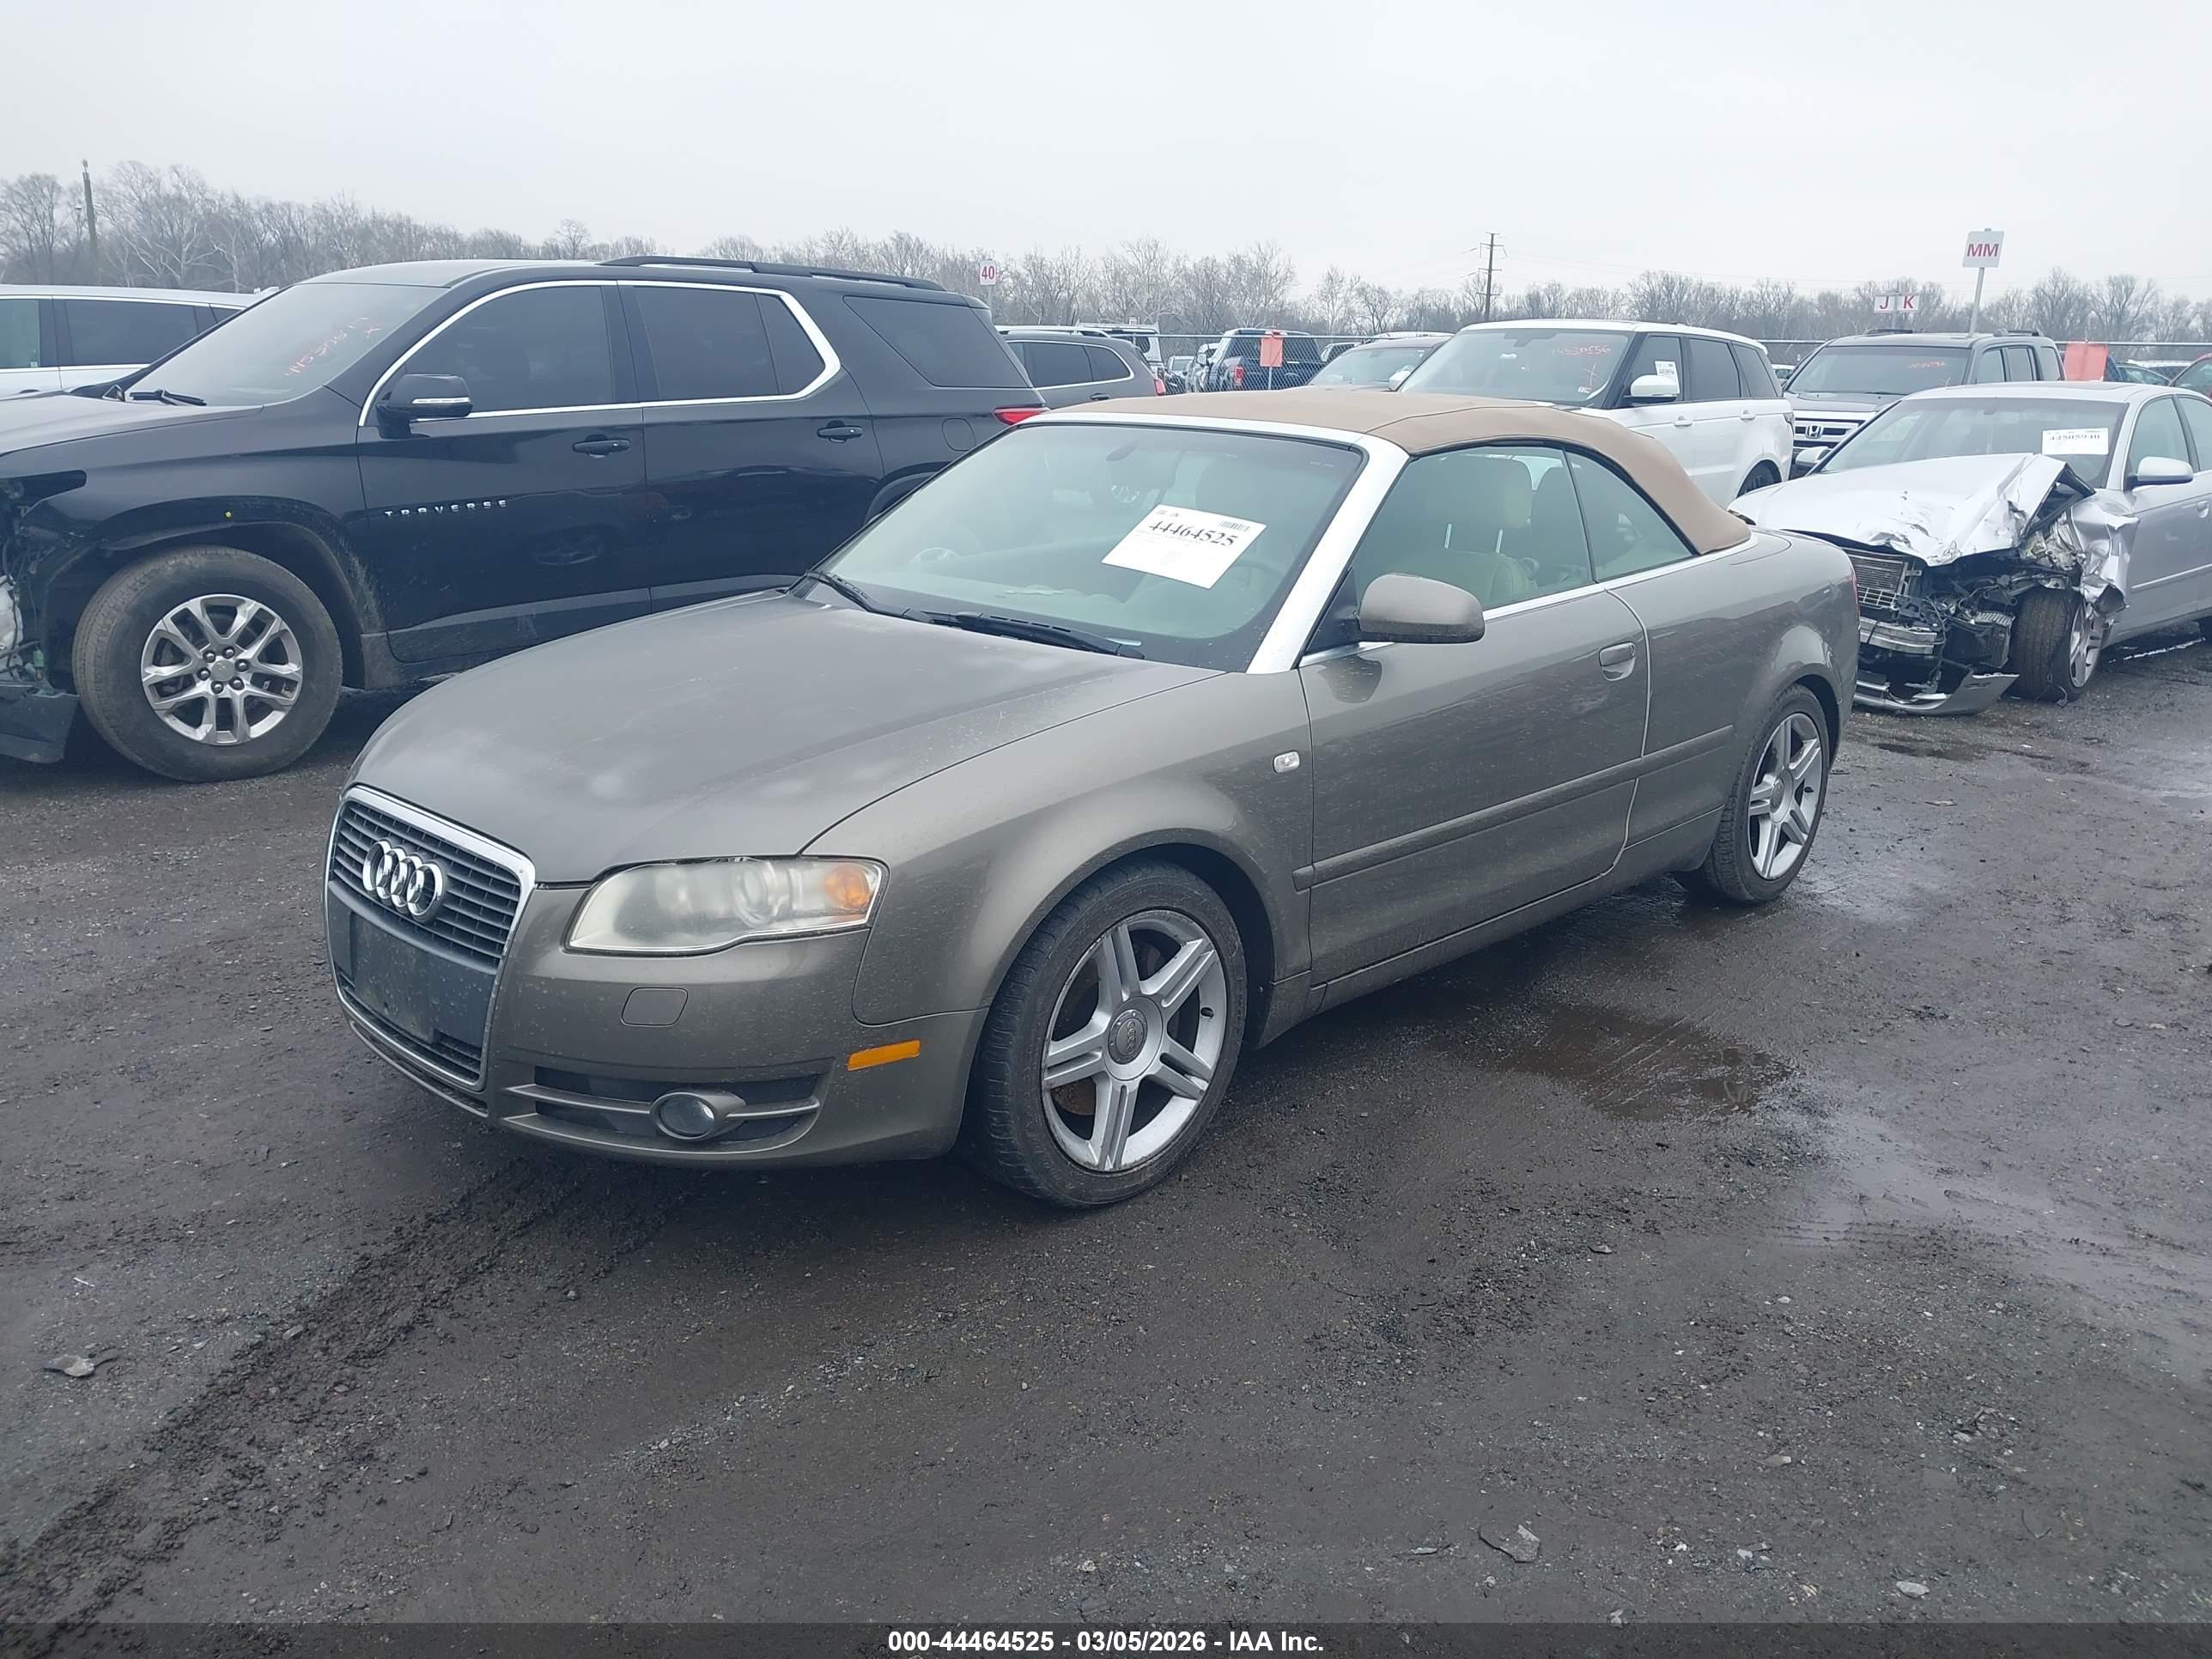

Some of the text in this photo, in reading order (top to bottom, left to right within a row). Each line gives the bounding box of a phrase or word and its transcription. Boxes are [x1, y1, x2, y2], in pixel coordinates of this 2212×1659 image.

[1966, 243, 1999, 258] MM
[981, 265, 995, 280] 40
[1879, 295, 1915, 310] J K
[384, 500, 507, 519] TRAVERSE
[1149, 520, 1239, 547] 44464525
